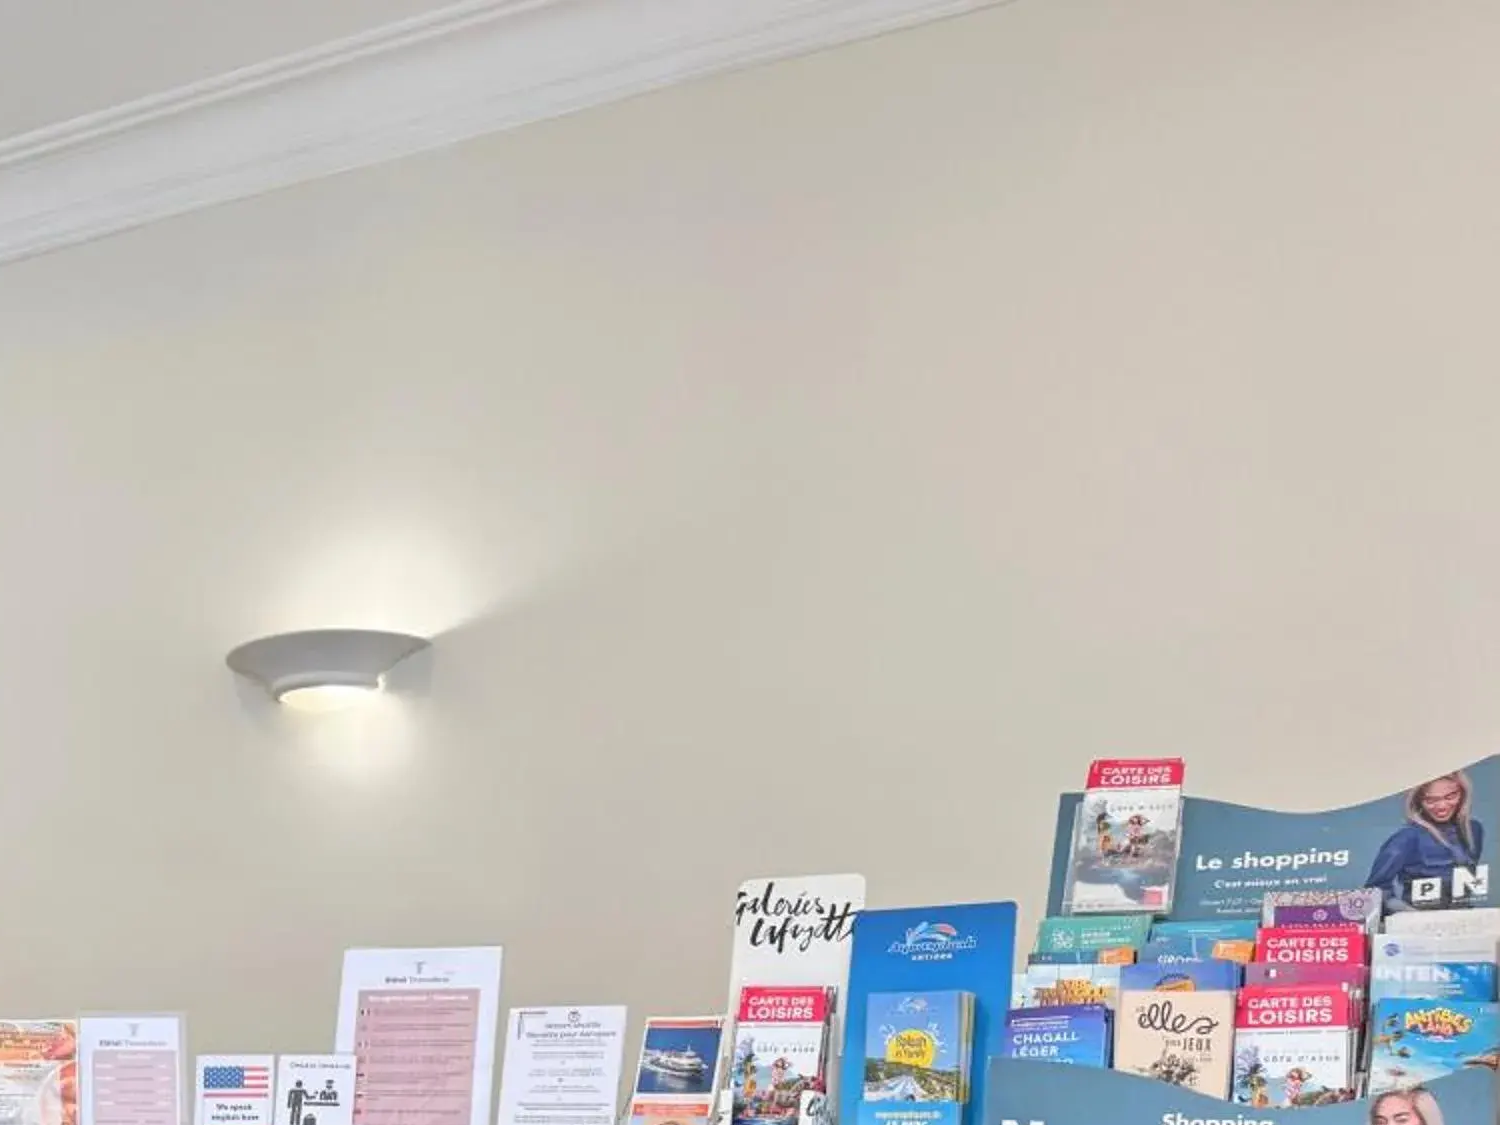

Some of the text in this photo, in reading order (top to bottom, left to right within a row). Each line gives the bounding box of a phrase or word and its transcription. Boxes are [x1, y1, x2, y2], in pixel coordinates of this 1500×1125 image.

[1102, 765, 1173, 776] CARTE DES
[1100, 774, 1171, 785] LOISIRS
[1195, 847, 1350, 872] Le shopping
[1213, 879, 1242, 889] C'est
[1244, 877, 1281, 888] mieux
[1284, 877, 1300, 886] en
[1451, 863, 1489, 899] N
[1266, 936, 1349, 949] CARTE DES
[1266, 949, 1349, 964] LOISIRS
[749, 996, 815, 1006] CARTE DES
[1248, 995, 1333, 1009] CARTE DES
[747, 1007, 814, 1019] LOISIRS
[1247, 1009, 1333, 1025] LOISIRS
[1012, 1031, 1081, 1046] CHAGALL
[1011, 1044, 1059, 1059] LÉGER
